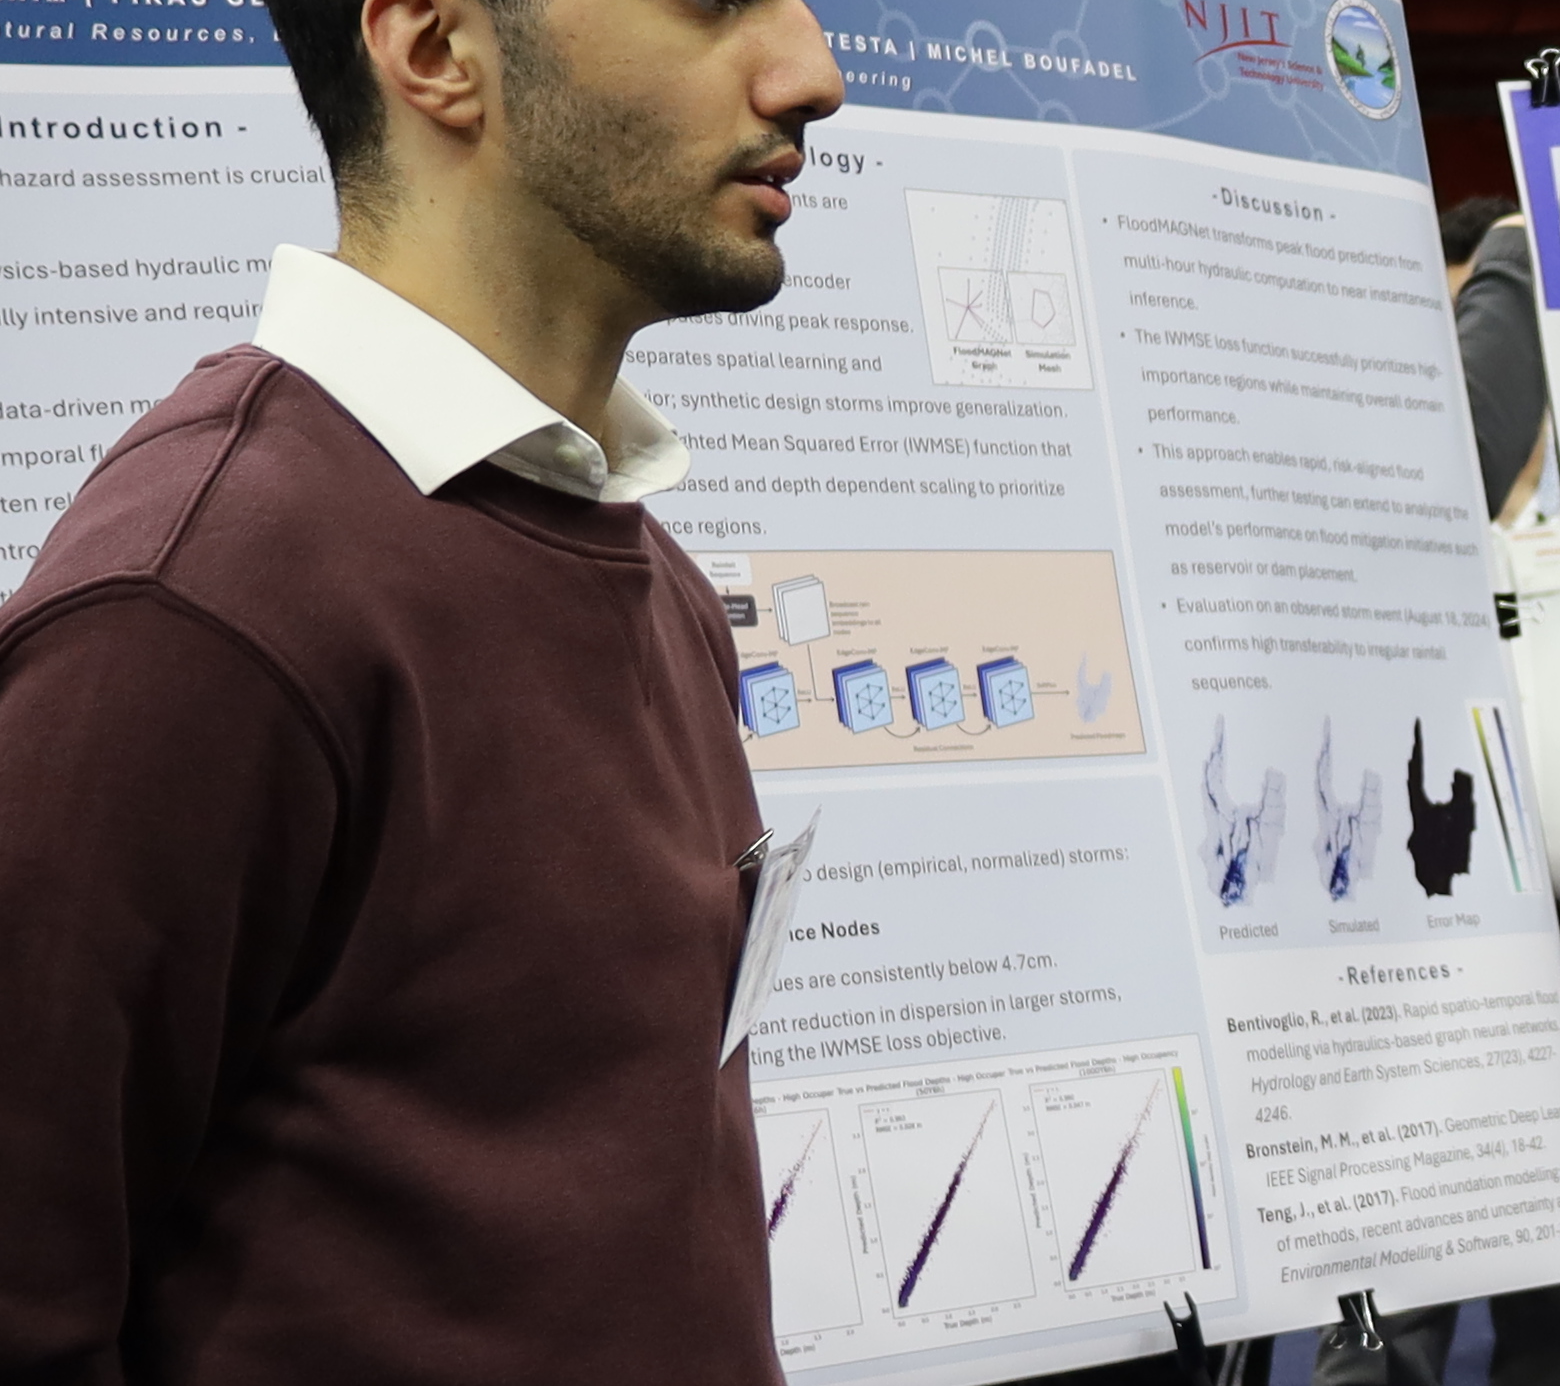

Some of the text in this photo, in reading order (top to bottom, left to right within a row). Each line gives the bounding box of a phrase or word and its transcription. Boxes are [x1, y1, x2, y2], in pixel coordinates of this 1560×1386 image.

[92, 23, 254, 43] Resources,
[825, 31, 1137, 82] TESTA MICHEL BOUFADEL
[82, 169, 220, 187] assessment
[226, 167, 244, 184] is
[250, 166, 325, 184] crucial
[731, 434, 1072, 458] Mean Squared Error (IWMSE) function that
[821, 921, 880, 939] Nodes
[1219, 913, 1480, 940] Predicted Simulated Error Map
[1227, 1013, 1309, 1033] Bentivoglio,
